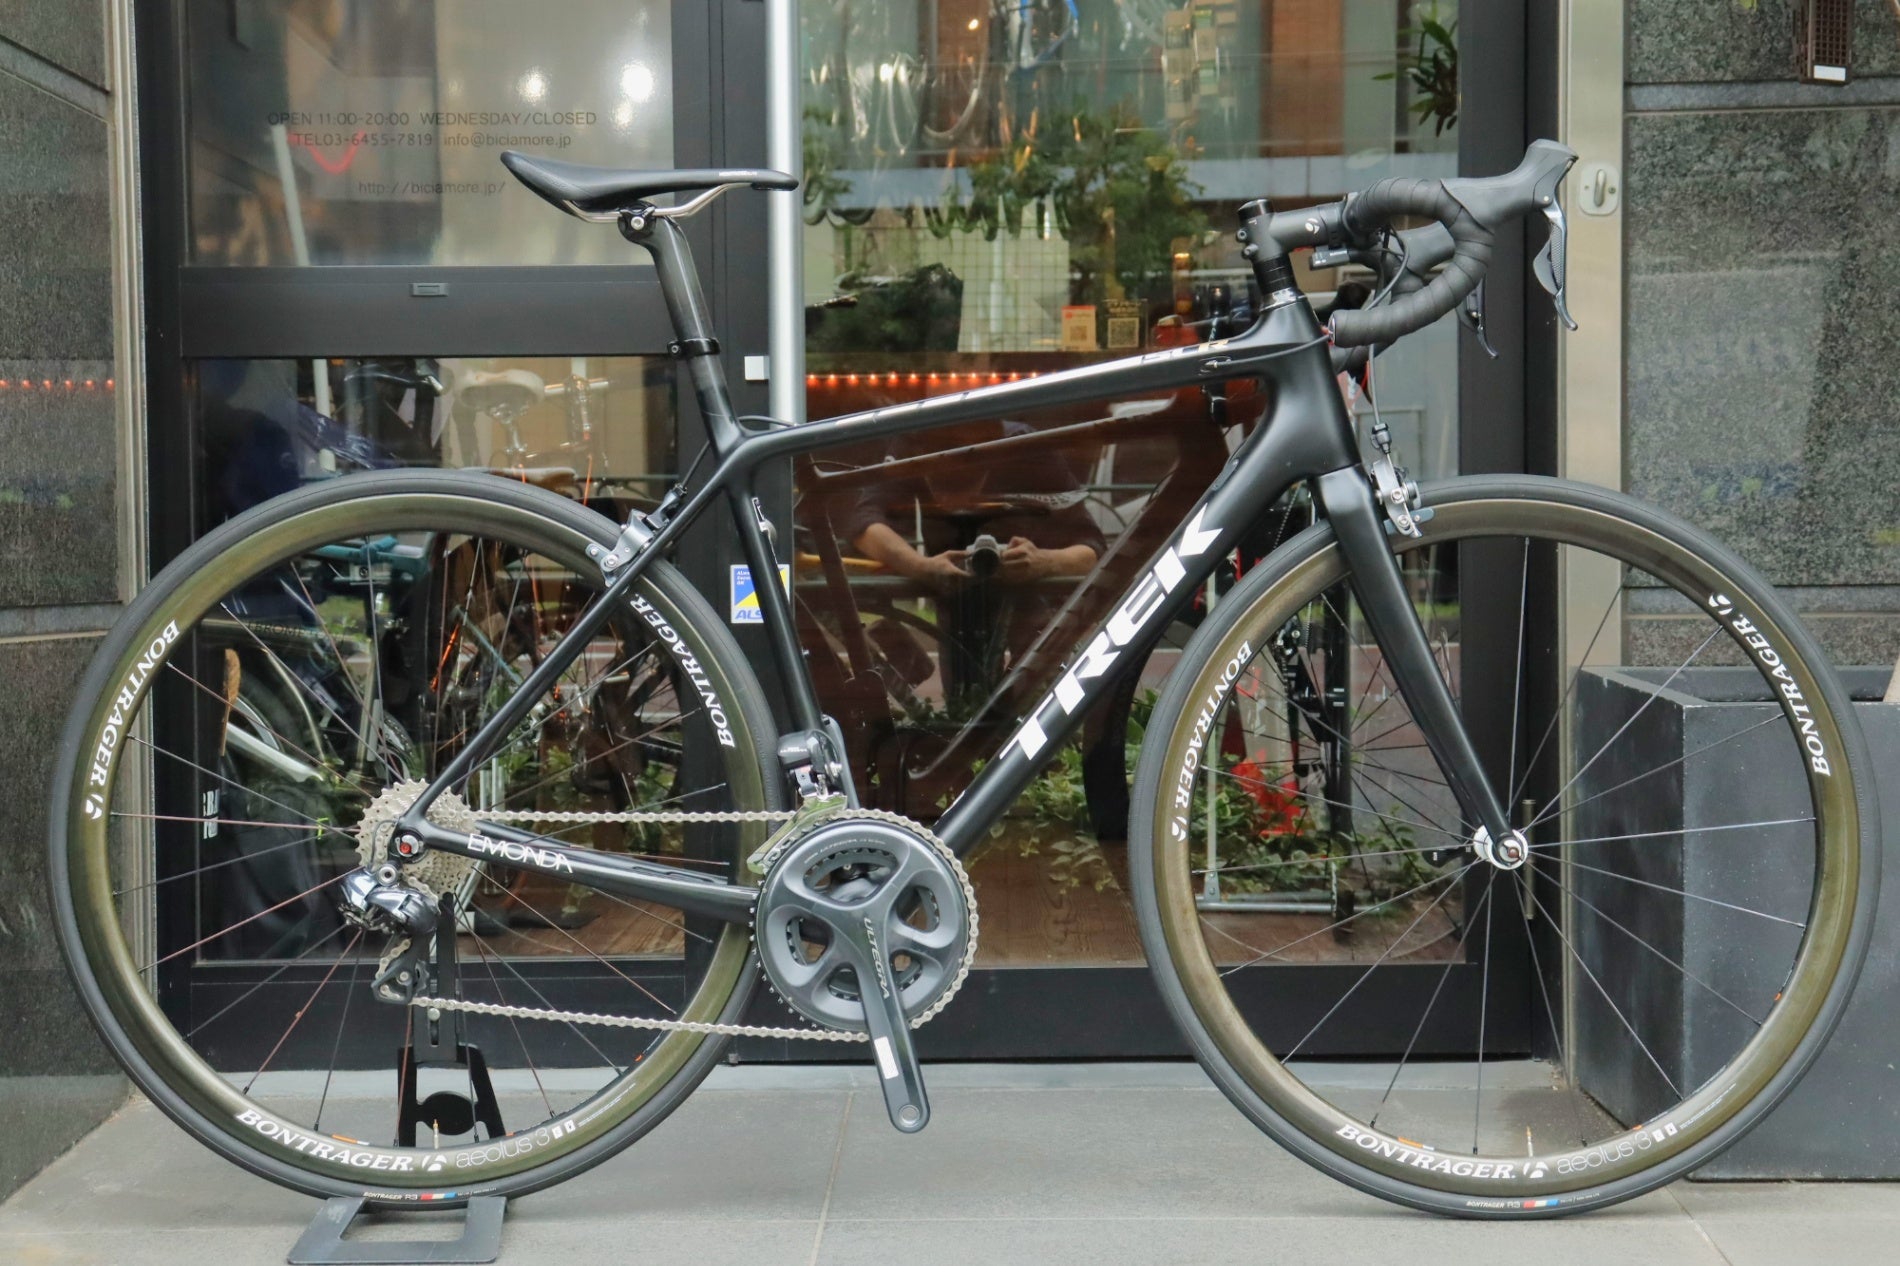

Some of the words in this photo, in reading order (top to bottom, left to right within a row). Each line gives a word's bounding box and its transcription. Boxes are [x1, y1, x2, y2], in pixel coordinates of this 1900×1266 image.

[268, 112, 312, 125] OPEN
[319, 112, 410, 125] 11:00-20:00
[420, 112, 597, 125] WEDNESDAY/CLOSED
[443, 132, 571, 148] info@biciamore.jp
[629, 593, 736, 749] BONTRAGER
[999, 503, 1223, 761] TREK
[90, 619, 181, 787] BONTRAGER
[1175, 640, 1252, 809] BONTRAGER
[1732, 614, 1831, 777] BONTRAGER
[864, 917, 890, 999] ULTEGRA
[235, 1109, 413, 1172] BONTRAGER
[456, 1137, 533, 1169] aeolus
[1335, 1124, 1515, 1179] BONTRAGER
[1557, 1141, 1634, 1175] aeolus
